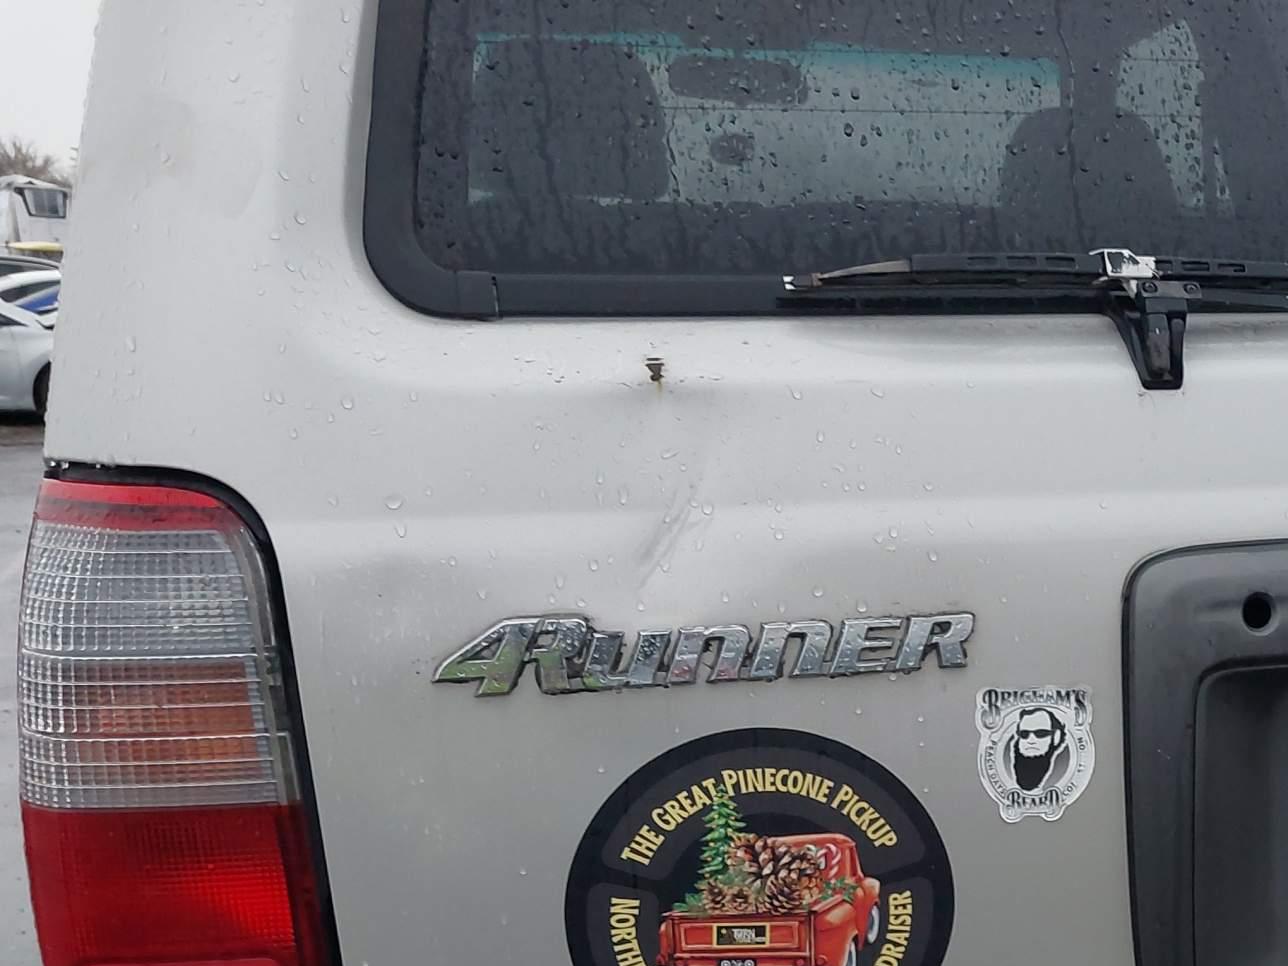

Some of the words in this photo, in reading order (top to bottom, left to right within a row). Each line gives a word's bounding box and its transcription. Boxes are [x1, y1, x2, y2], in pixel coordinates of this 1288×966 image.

[621, 828, 664, 866] THE
[651, 777, 717, 833] GREAT
[721, 768, 834, 803] PINECONE
[830, 784, 898, 850] PICKUP
[1005, 789, 1062, 819] BEARD
